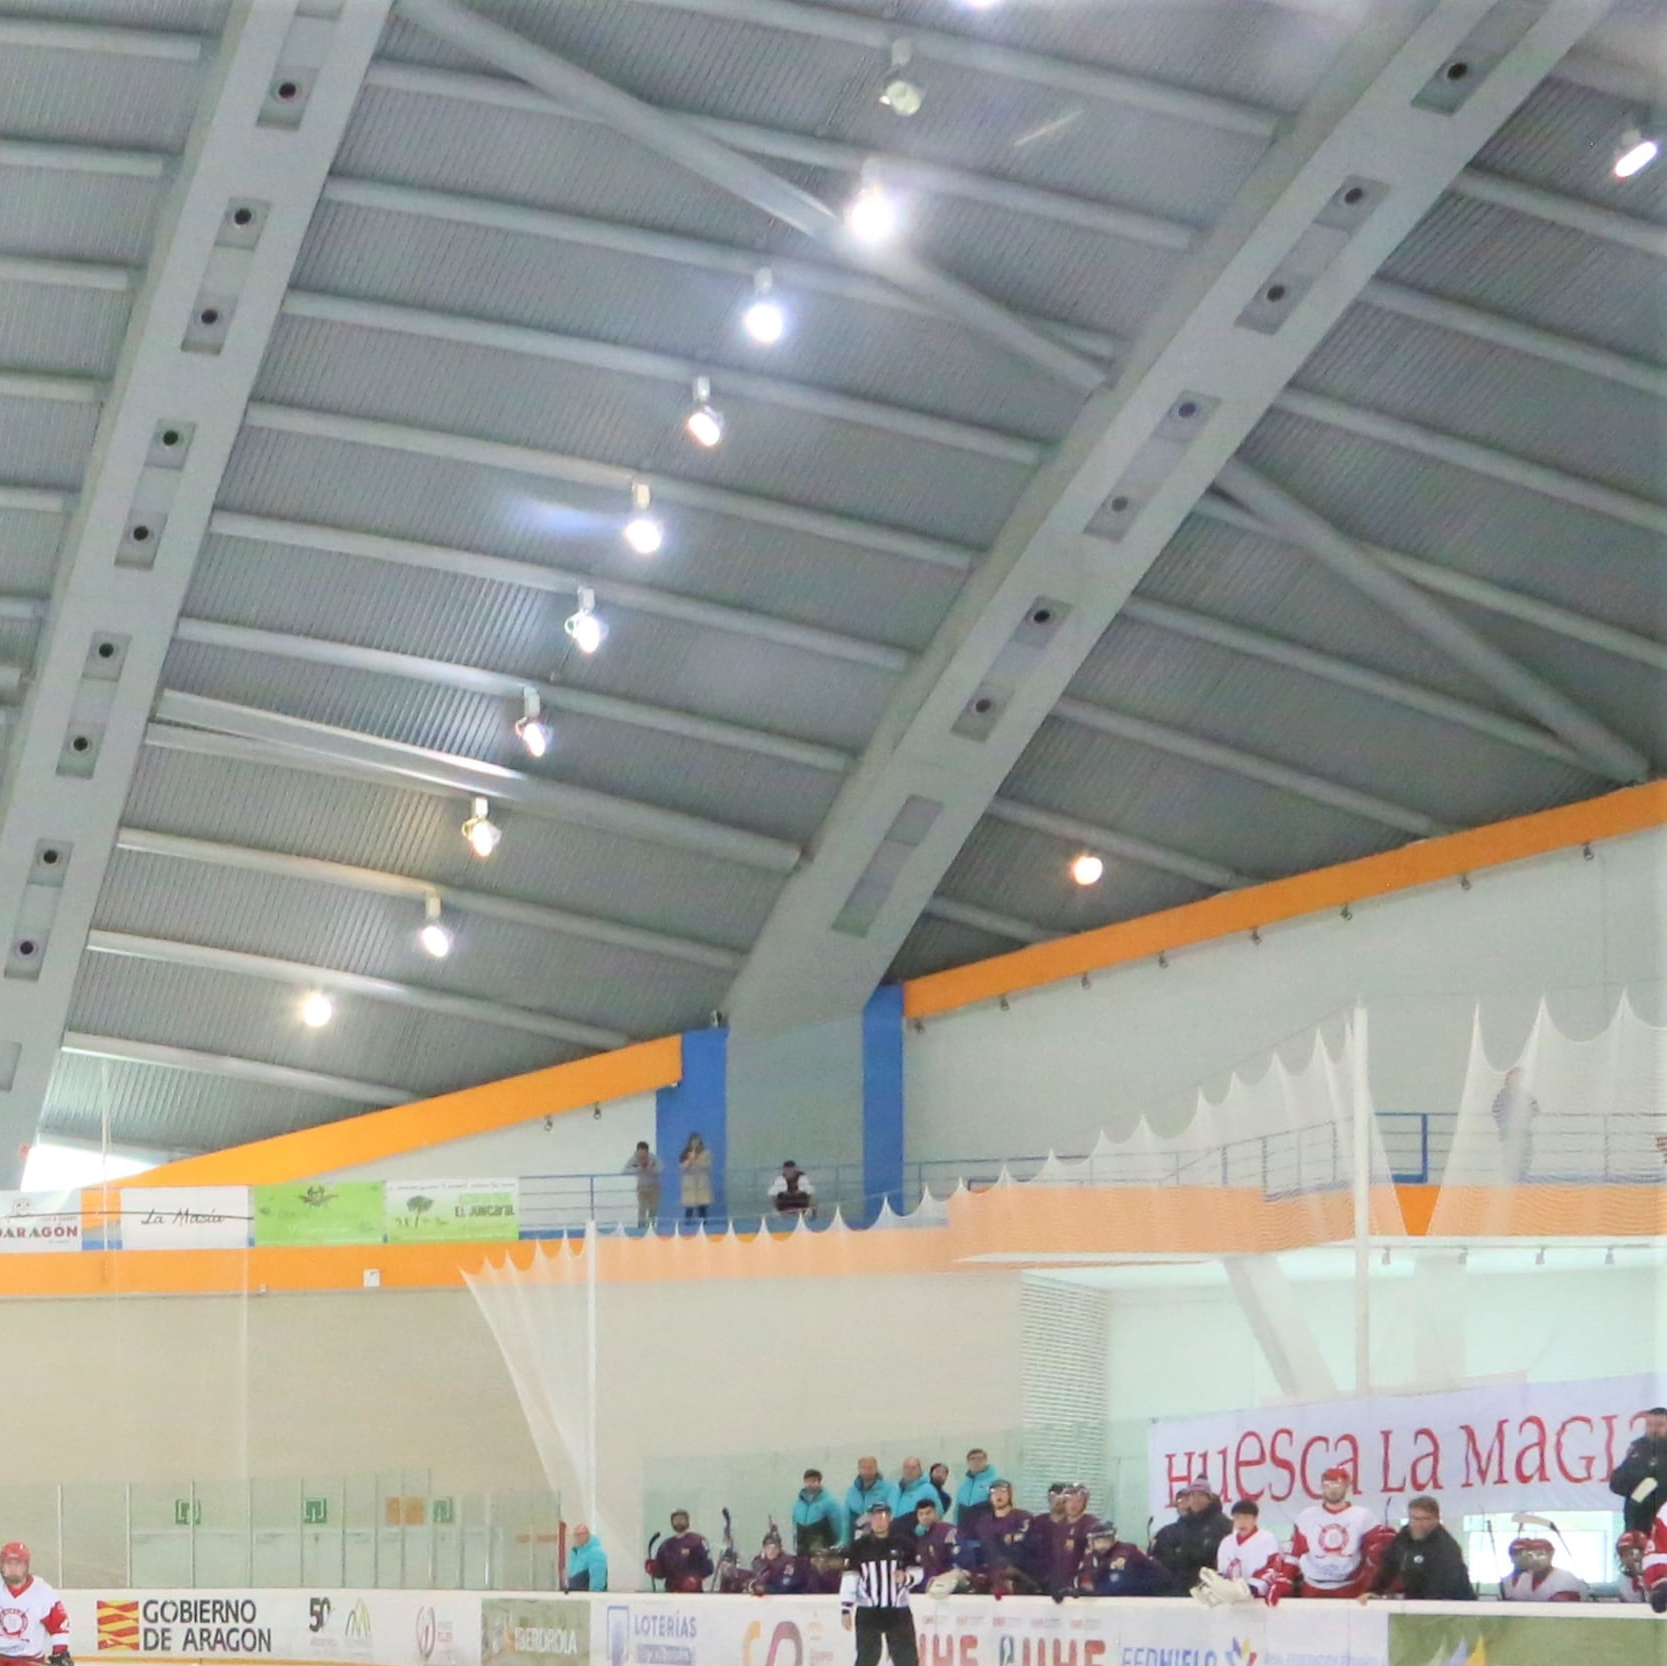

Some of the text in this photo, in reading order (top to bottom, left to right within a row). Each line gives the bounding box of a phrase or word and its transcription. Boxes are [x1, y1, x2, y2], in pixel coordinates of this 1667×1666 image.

[140, 1206, 226, 1227] La Masía
[142, 1598, 257, 1626] GOBIERNO
[633, 1610, 698, 1638] LOTERÍAS
[142, 1627, 172, 1653] DE
